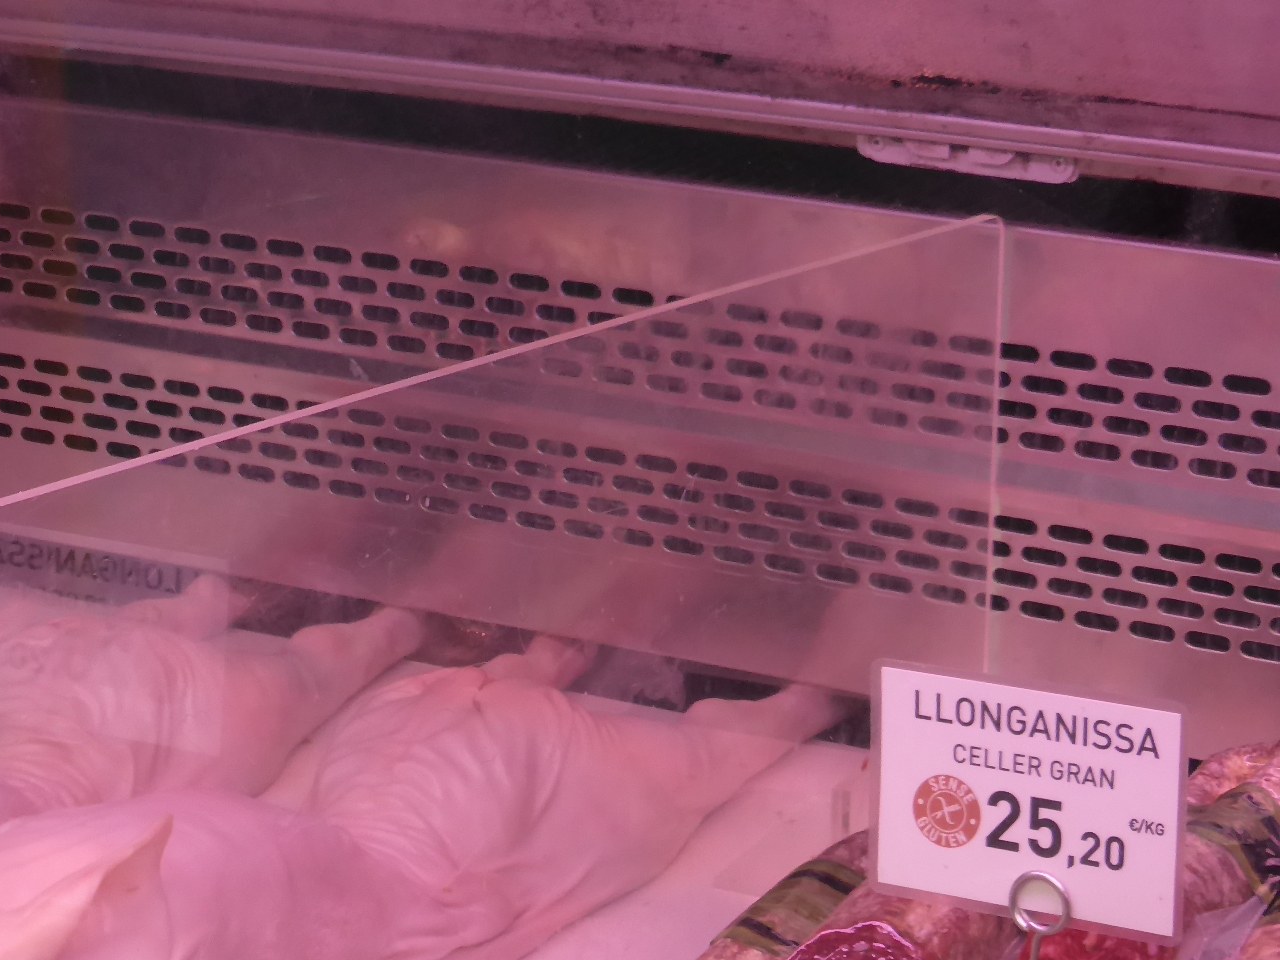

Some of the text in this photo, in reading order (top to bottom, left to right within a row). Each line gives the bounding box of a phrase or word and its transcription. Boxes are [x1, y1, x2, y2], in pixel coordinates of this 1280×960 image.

[914, 688, 1160, 760] LLONGANISSA
[928, 775, 975, 805] SENSE
[952, 743, 1116, 790] CELLER GRAN
[917, 816, 967, 846] GLUTEN
[985, 790, 1166, 871] 25,20 €/KG
